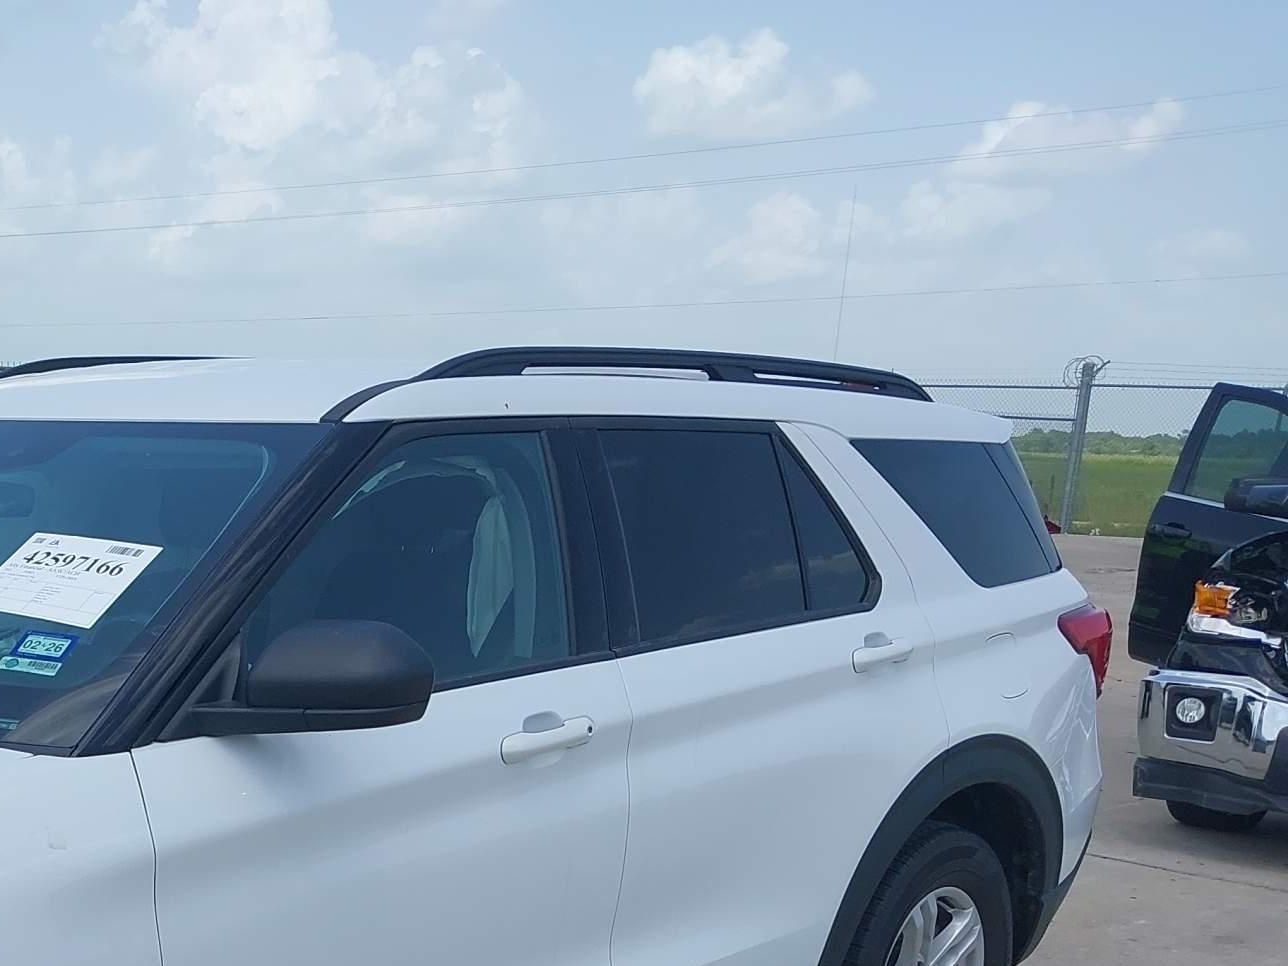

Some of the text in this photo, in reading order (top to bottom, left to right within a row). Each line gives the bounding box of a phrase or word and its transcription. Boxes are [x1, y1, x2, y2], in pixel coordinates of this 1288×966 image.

[23, 550, 129, 577] 42597166
[23, 639, 65, 653] 02 26
